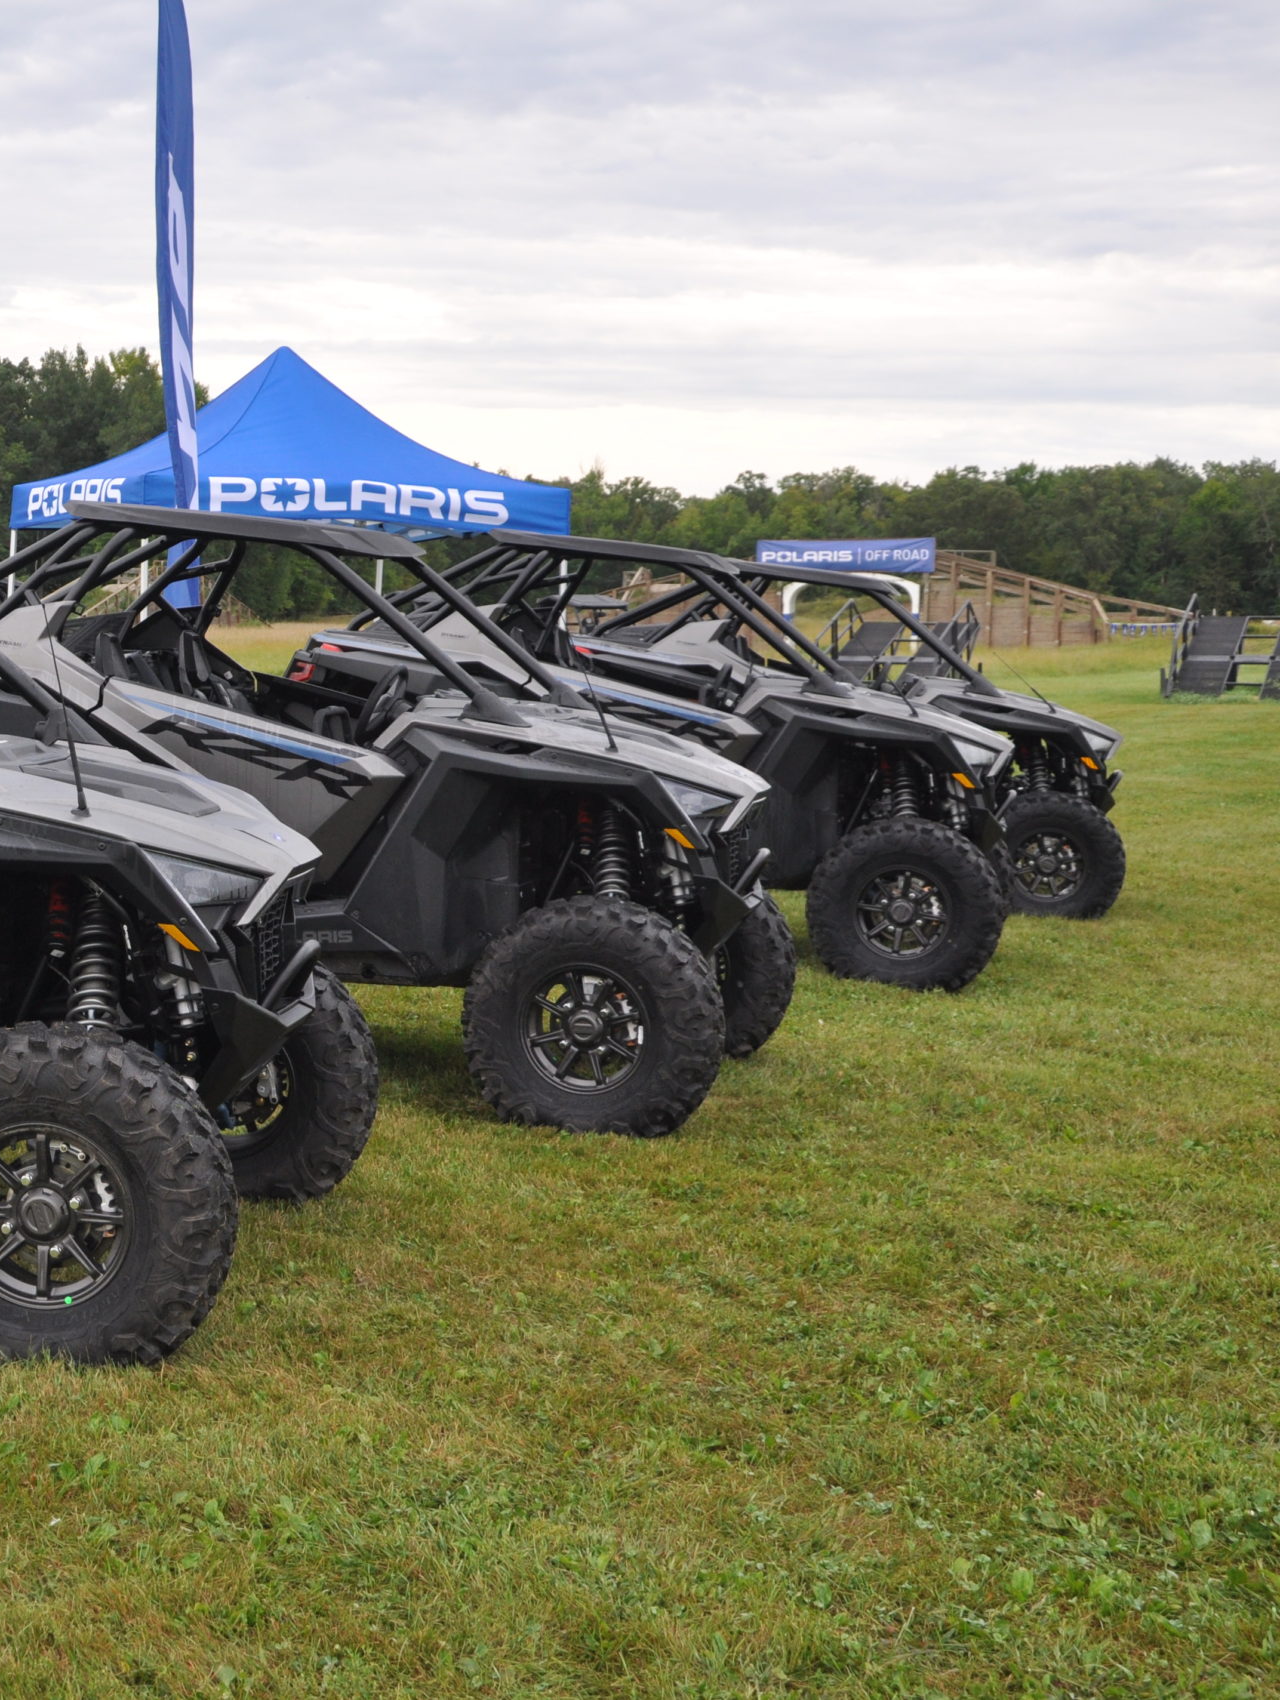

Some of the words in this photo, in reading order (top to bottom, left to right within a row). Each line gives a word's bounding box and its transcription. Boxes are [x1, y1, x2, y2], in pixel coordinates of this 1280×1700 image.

[208, 476, 510, 526] POLARIS
[761, 550, 853, 562] POLARIS
[865, 550, 889, 561] OFF
[893, 549, 929, 561] ROAD
[138, 714, 373, 800] RZR
